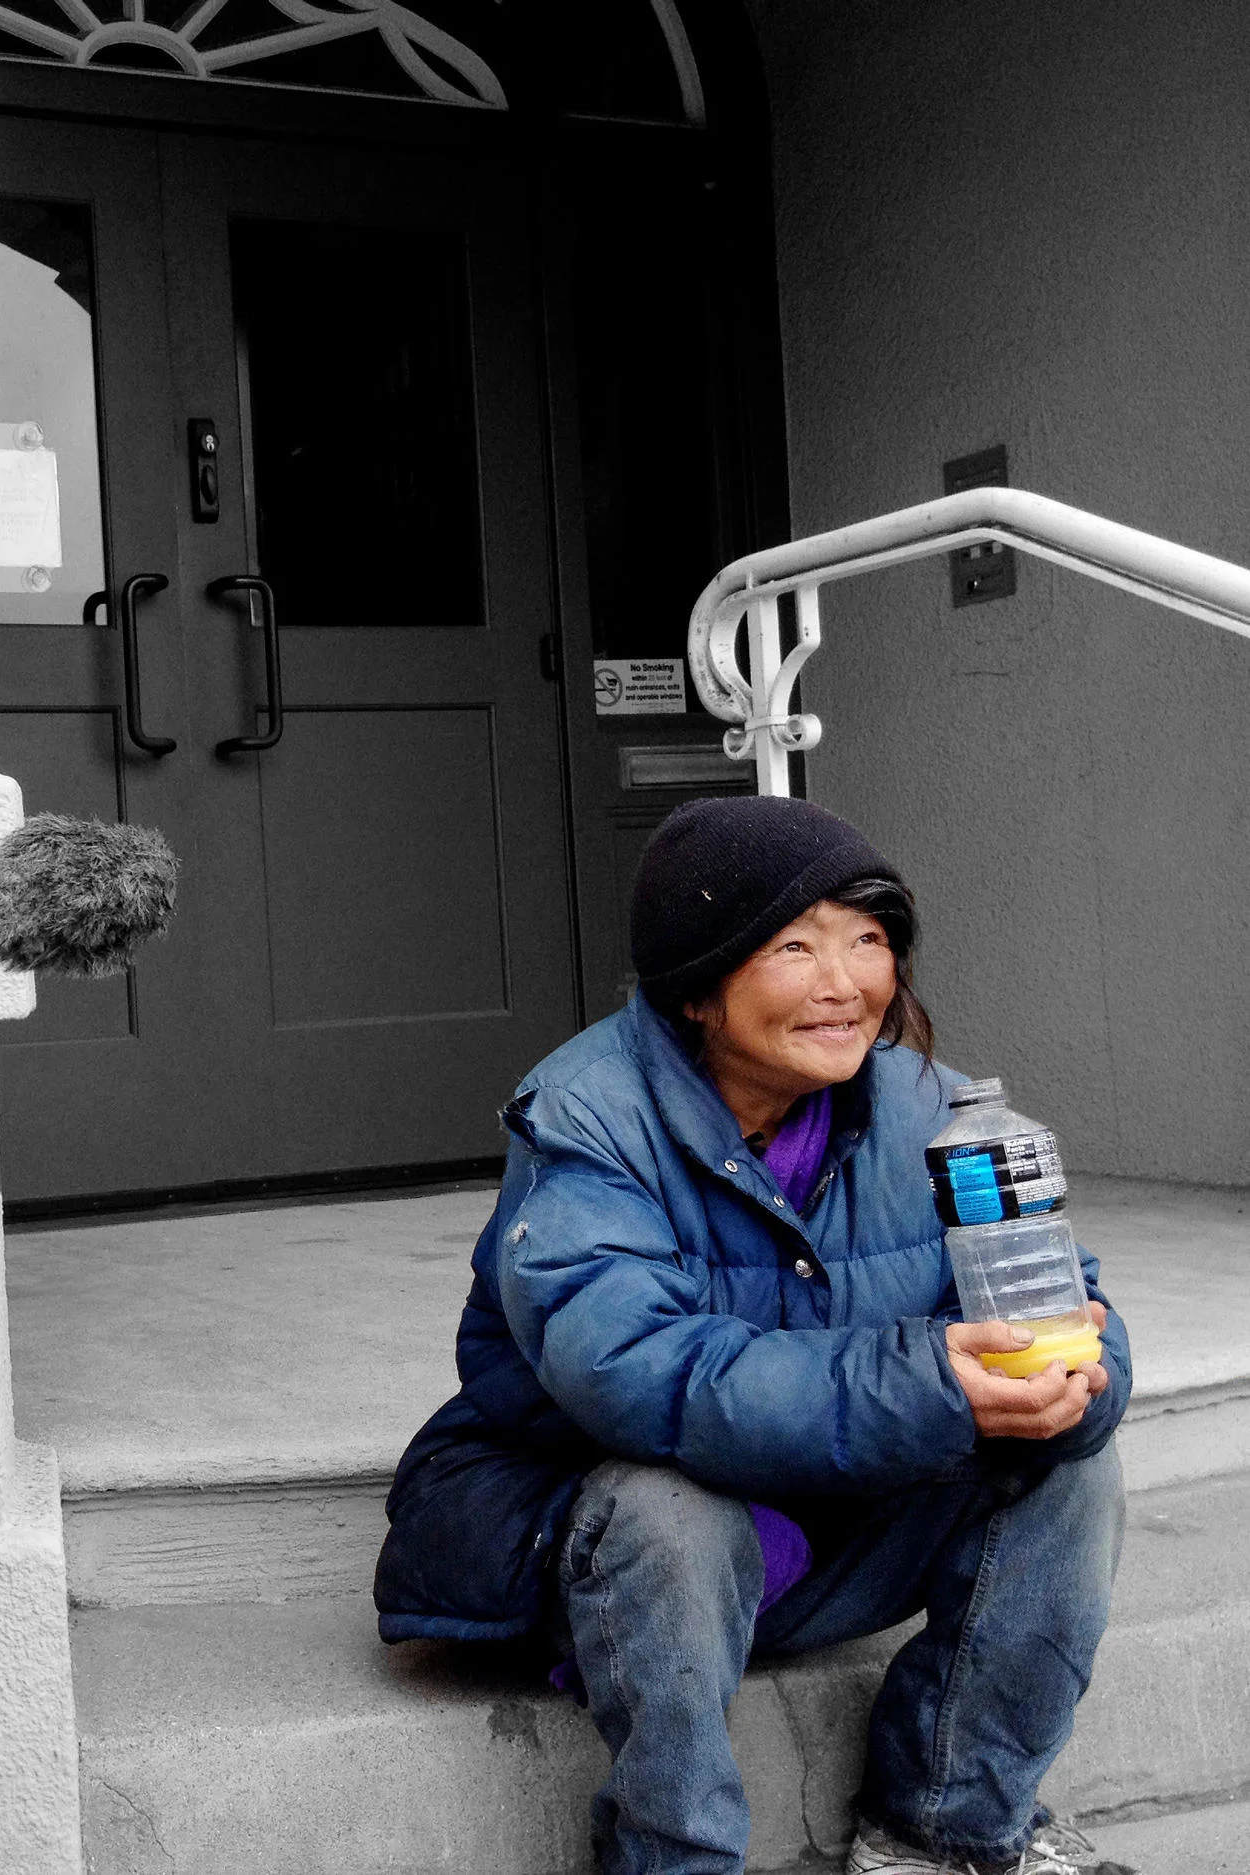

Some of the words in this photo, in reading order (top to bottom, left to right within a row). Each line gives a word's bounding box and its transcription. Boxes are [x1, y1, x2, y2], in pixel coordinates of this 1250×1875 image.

[630, 663, 641, 672] No
[642, 663, 674, 673] Smoking
[637, 693, 659, 701] operable
